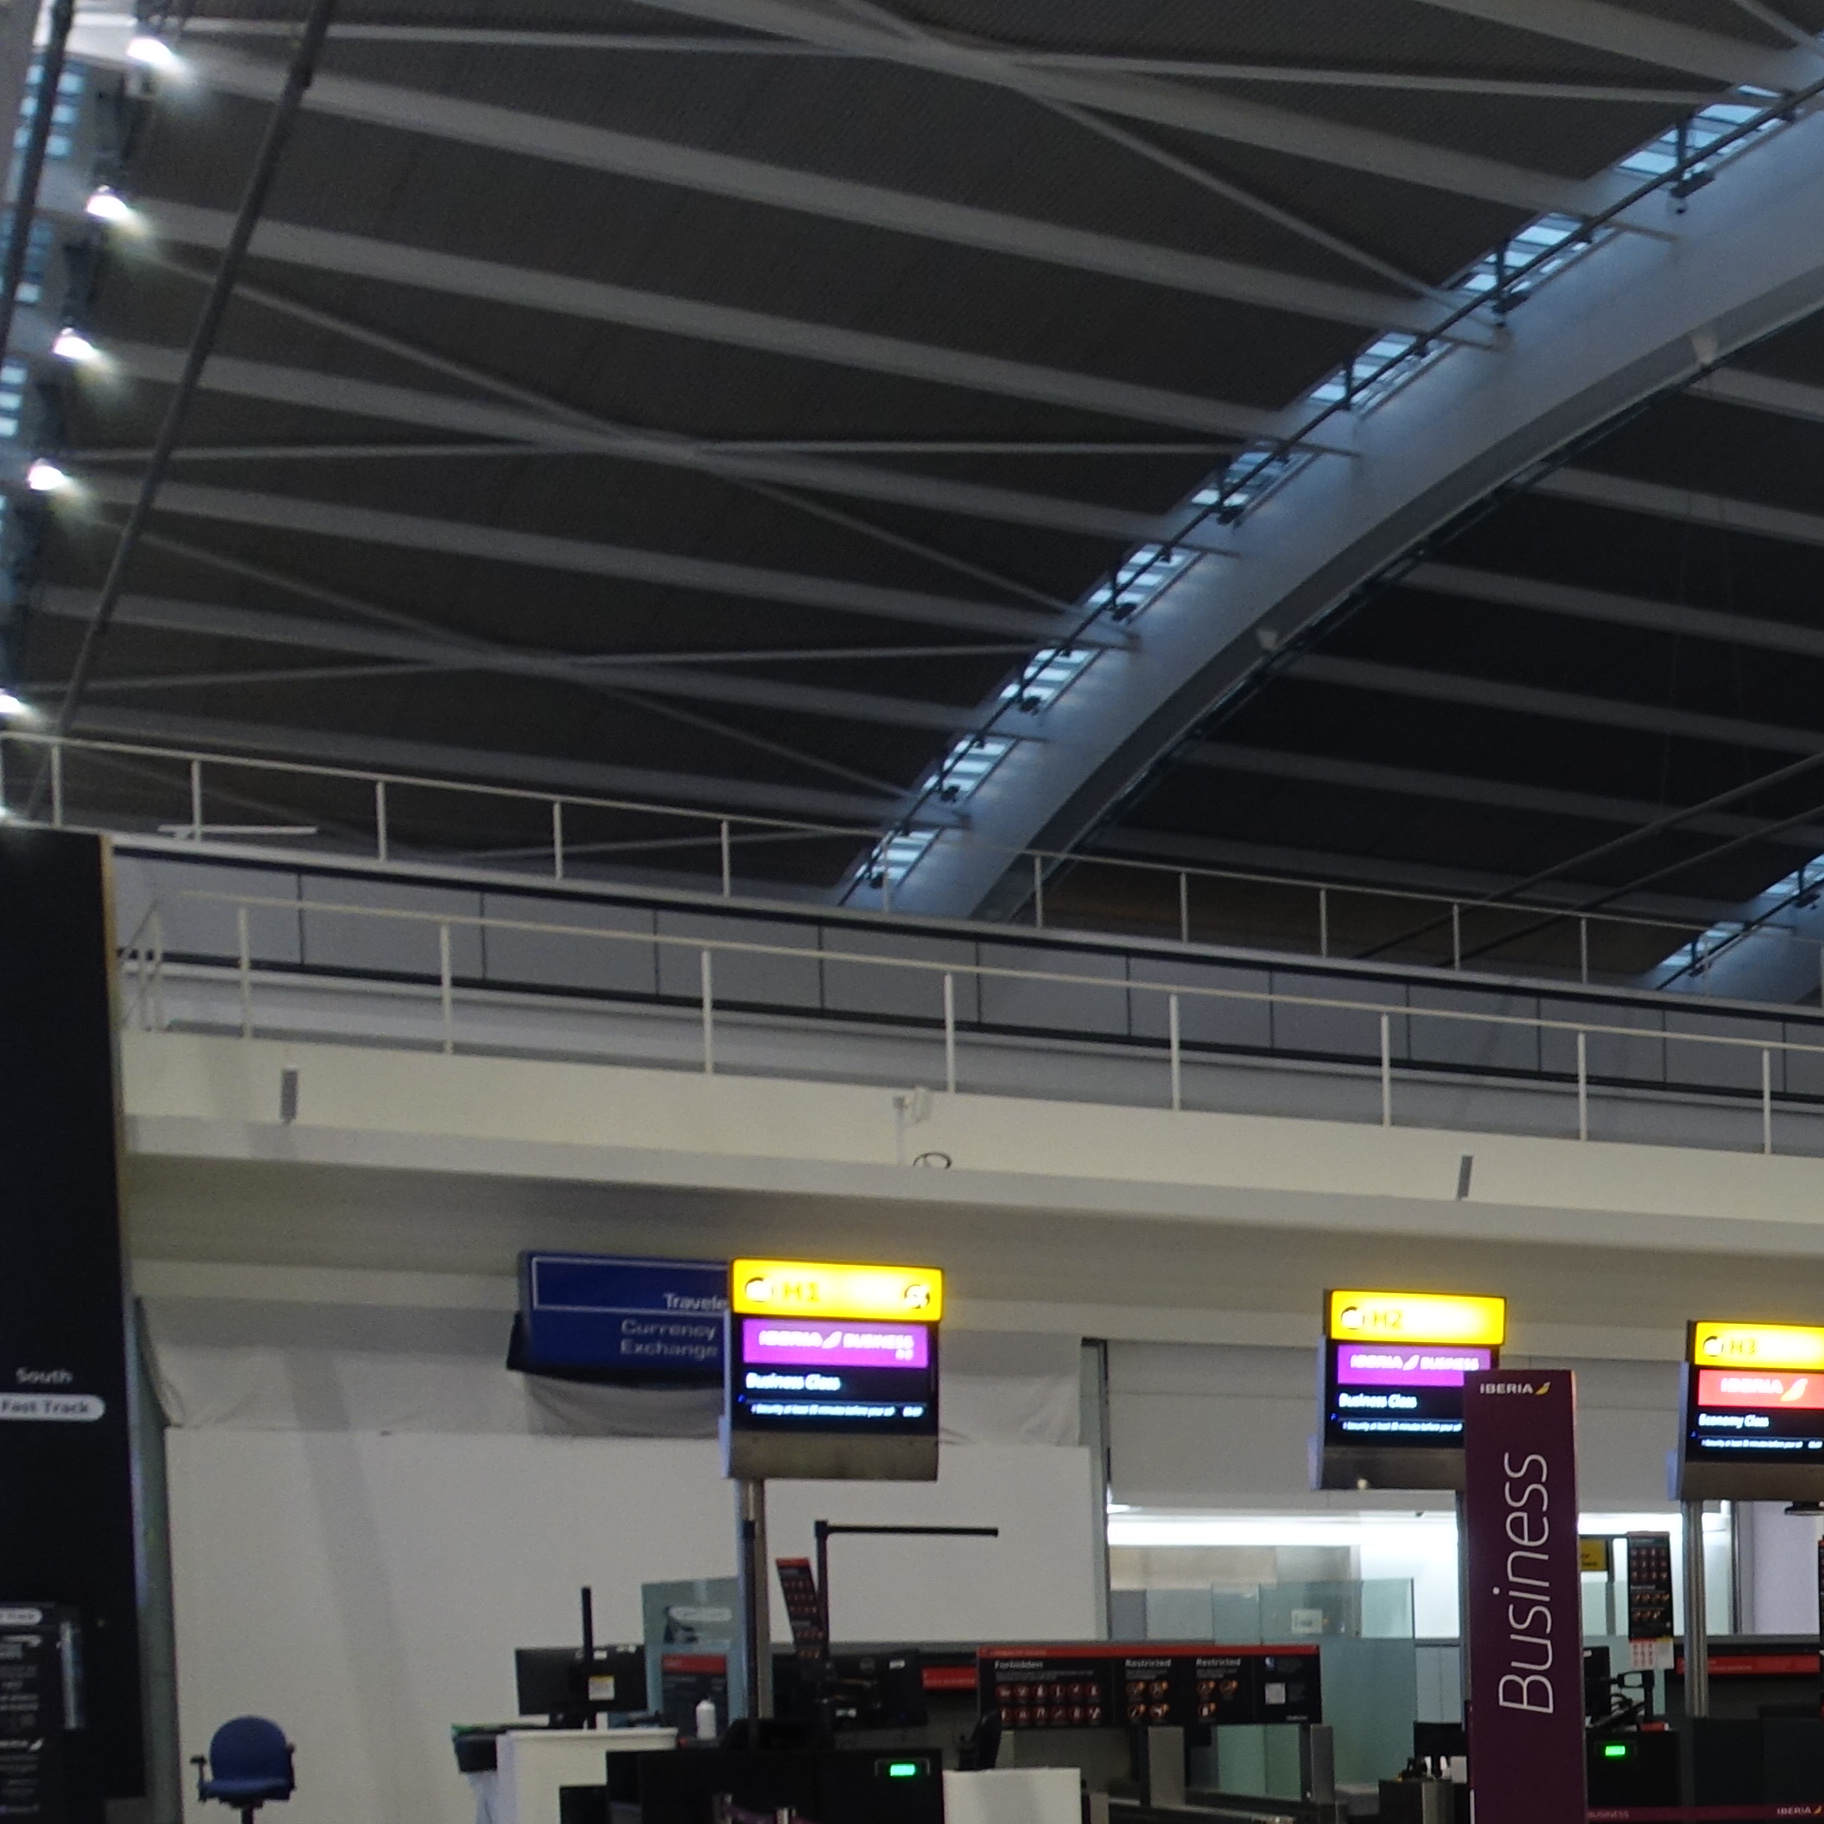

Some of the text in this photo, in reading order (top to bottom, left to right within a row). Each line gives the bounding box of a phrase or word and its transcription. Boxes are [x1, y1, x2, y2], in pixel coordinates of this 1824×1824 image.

[662, 1292, 725, 1311] Travele
[621, 1318, 716, 1338] Currency
[759, 1331, 823, 1348] IBERIA
[620, 1338, 719, 1360] Exchange
[1350, 1355, 1403, 1369] IBERIA
[16, 1367, 73, 1384] South
[745, 1372, 841, 1392] Business Class
[1479, 1383, 1534, 1395] IBERIA
[45, 1400, 88, 1413] Track
[1338, 1393, 1417, 1409] Business Class
[1493, 1451, 1554, 1714] Business
[994, 1659, 1044, 1670] Forbidden
[1125, 1658, 1172, 1668] Restricted
[1196, 1656, 1242, 1667] Restricted
[1777, 1805, 1812, 1815] IBERIA
